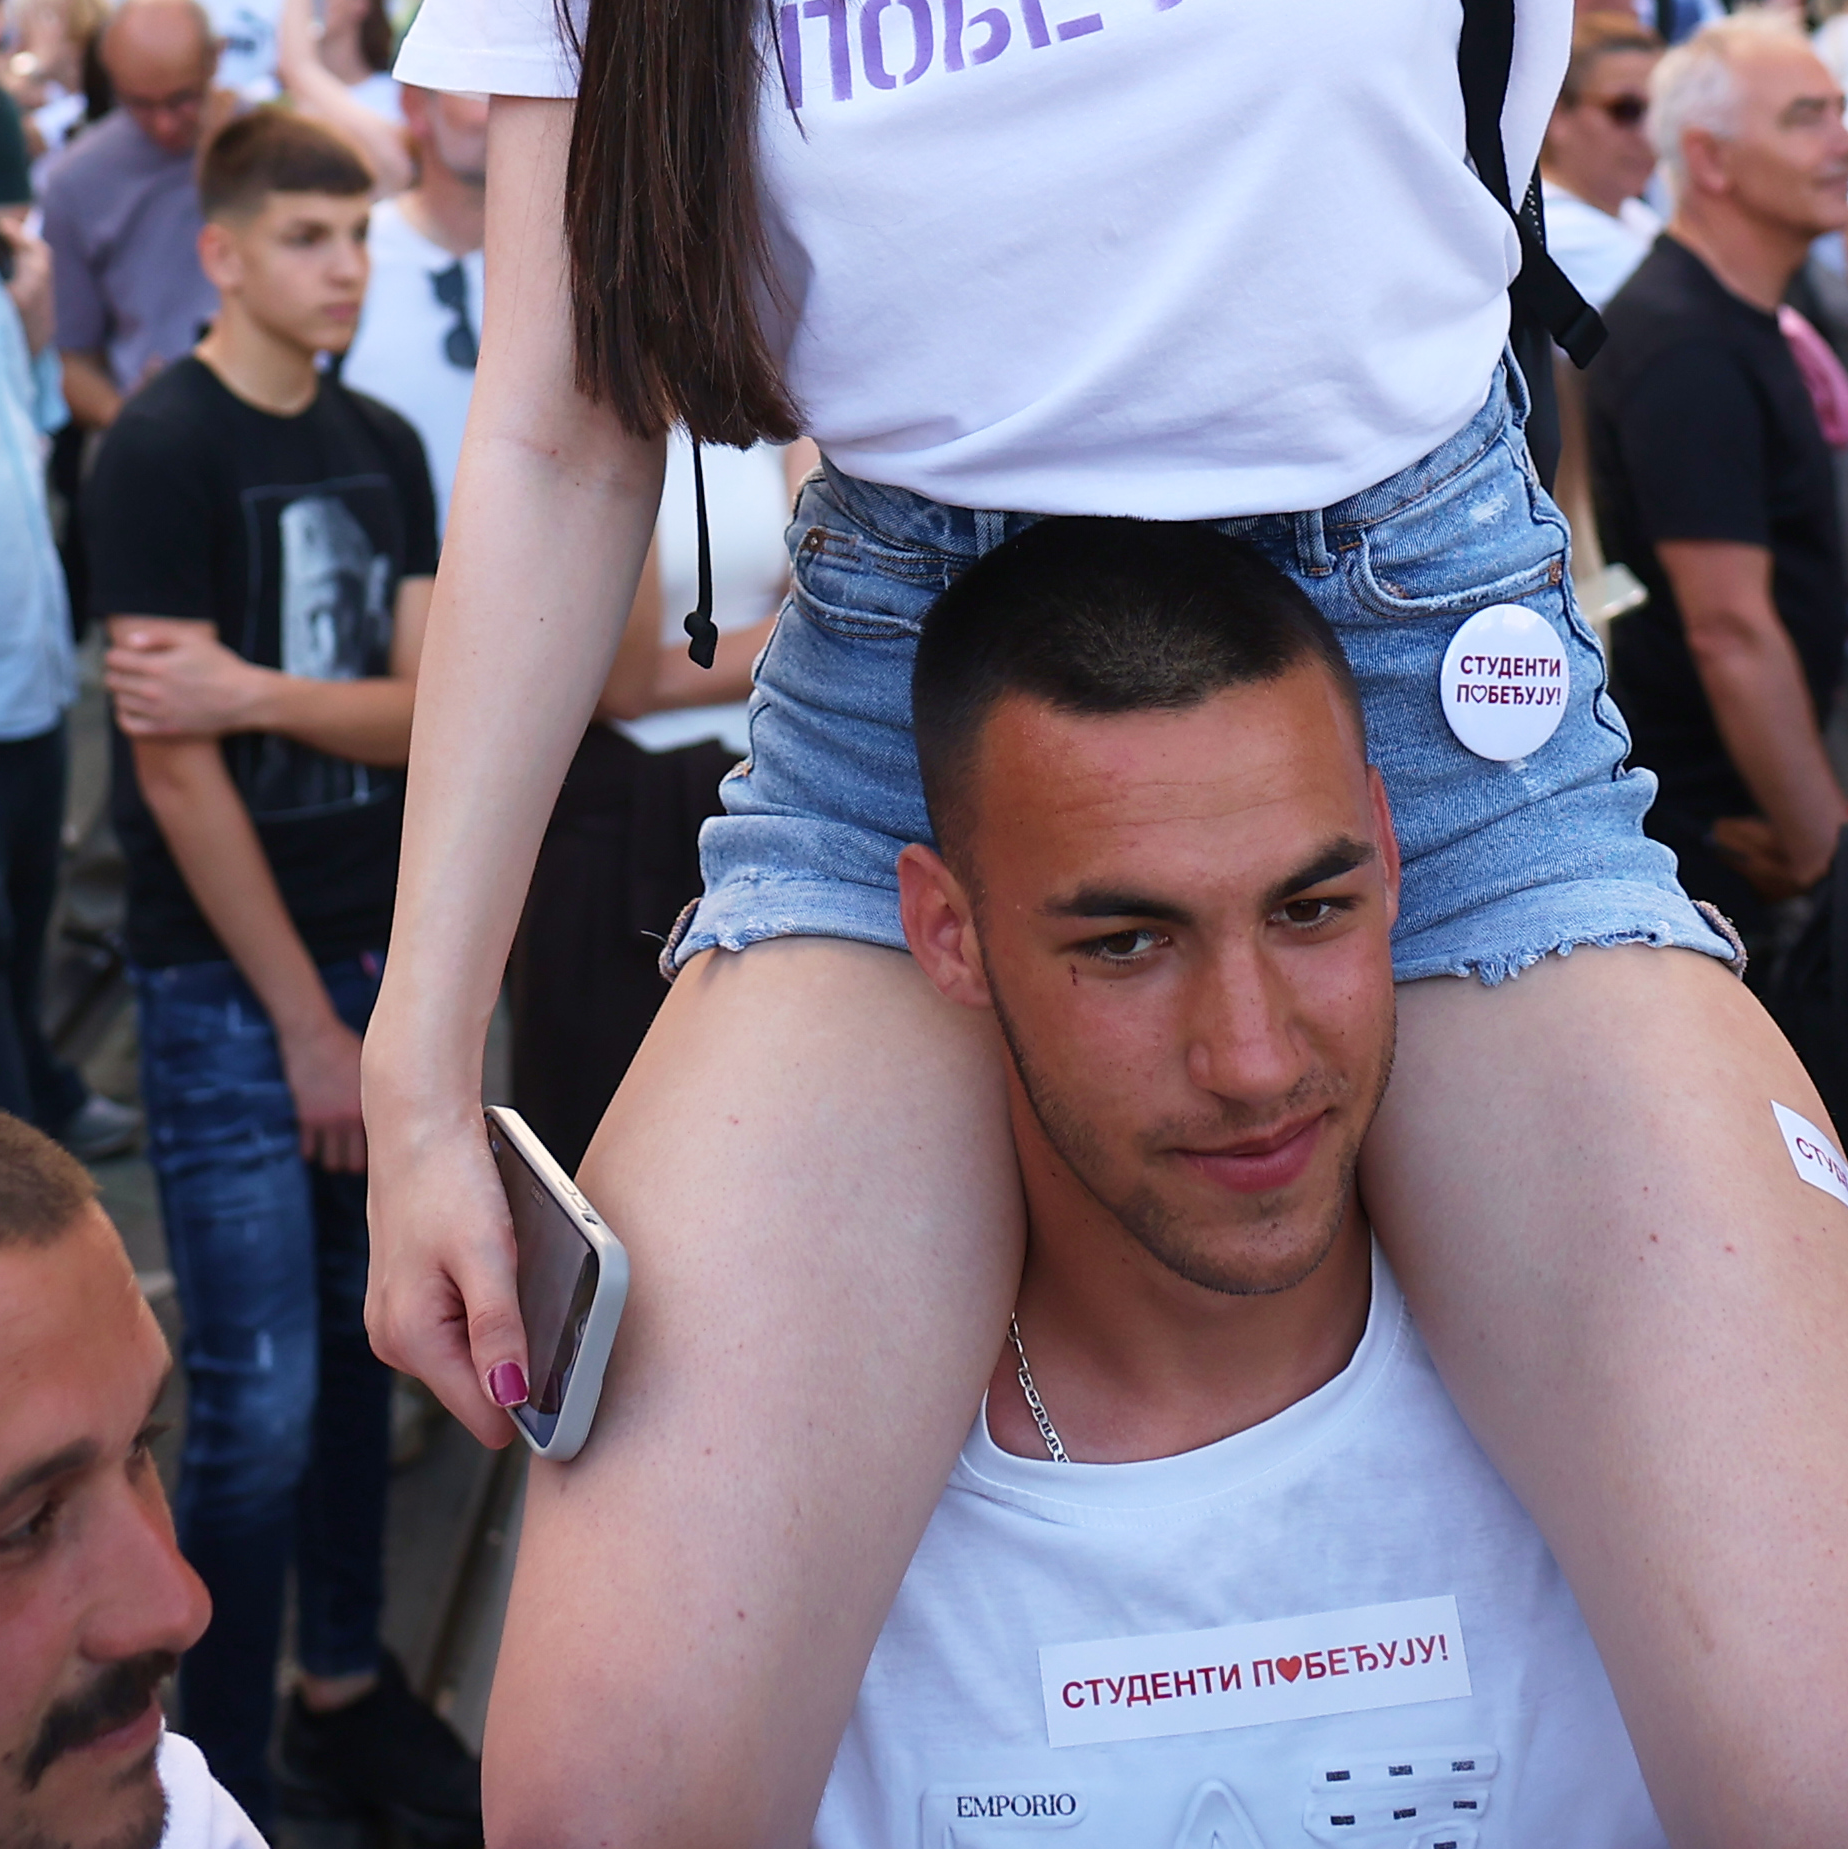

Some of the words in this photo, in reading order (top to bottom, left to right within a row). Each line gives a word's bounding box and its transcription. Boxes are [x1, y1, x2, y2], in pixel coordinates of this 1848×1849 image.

[1460, 655, 1561, 679] СТУДЕНТИ
[1061, 1663, 1242, 1709] СТУДЕНТИ
[955, 1792, 1078, 1819] EMPORIO
